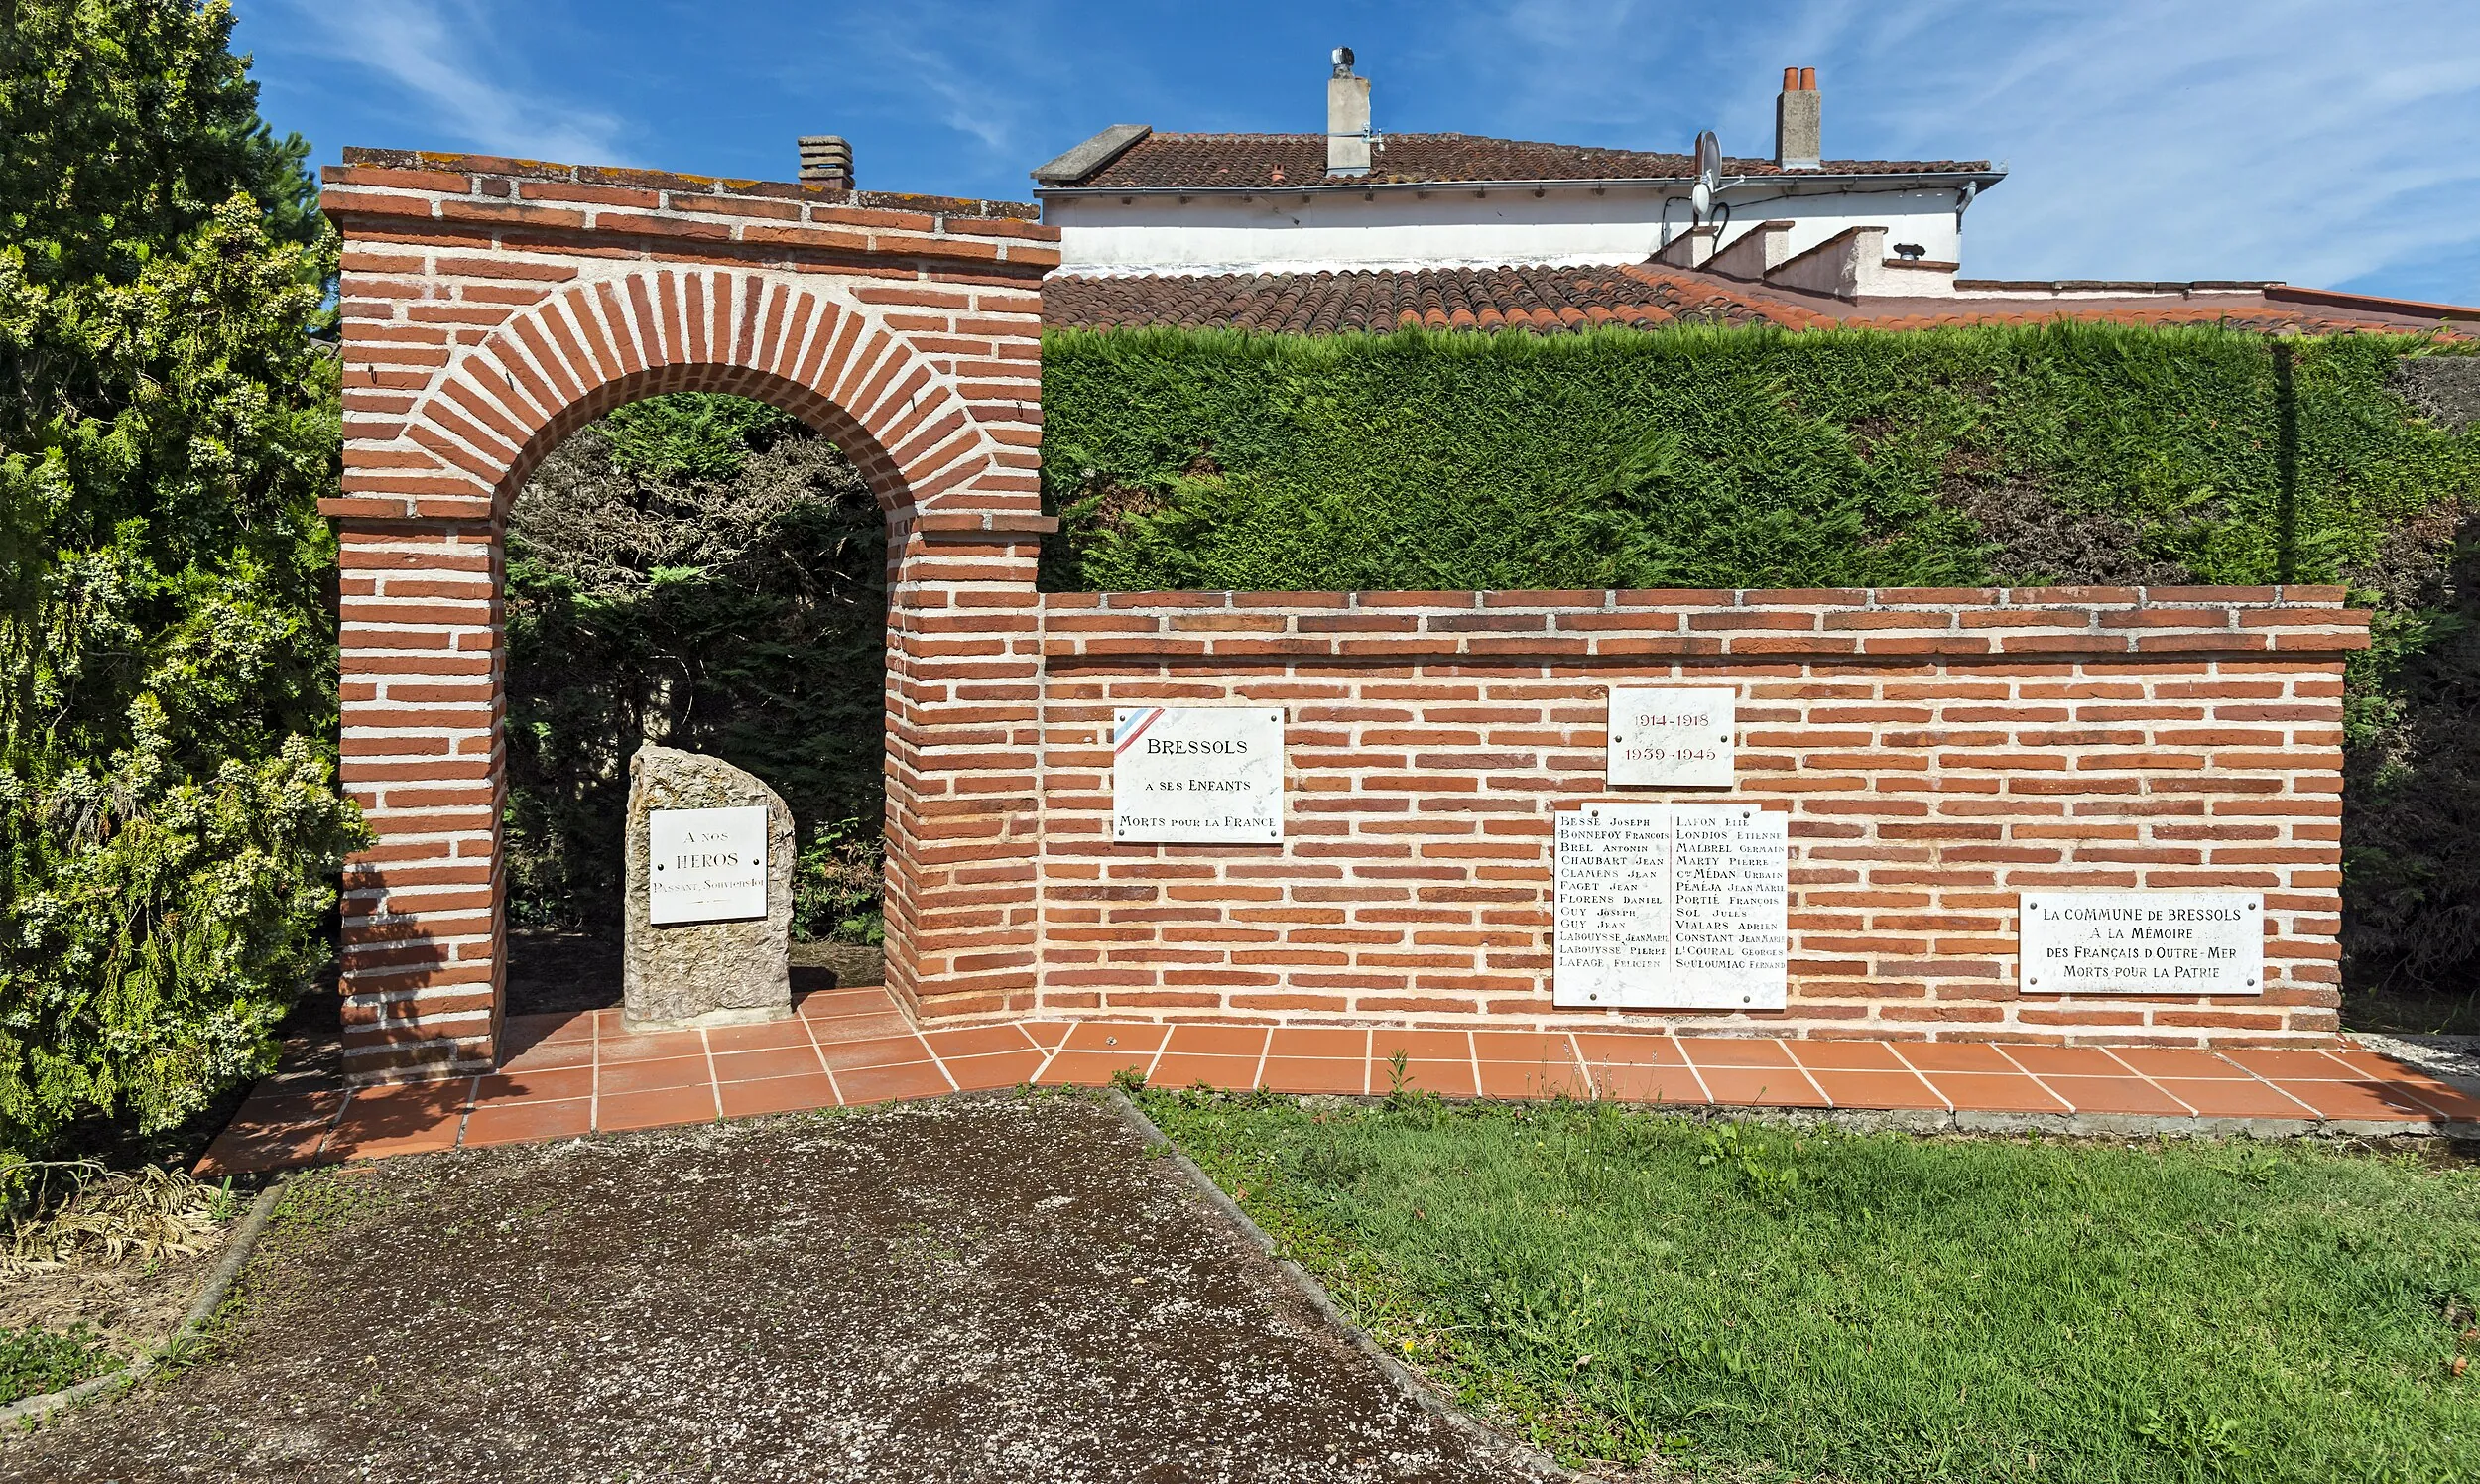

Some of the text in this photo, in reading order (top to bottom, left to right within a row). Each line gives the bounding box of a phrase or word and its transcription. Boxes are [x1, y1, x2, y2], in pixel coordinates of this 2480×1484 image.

[1635, 714, 1709, 727] 1914-1918
[1147, 738, 1248, 755] BRESSOLS
[1159, 781, 1183, 791] SES
[1188, 779, 1251, 791] ENFANTS
[1119, 815, 1166, 827] MORTS
[1224, 816, 1276, 827] FRANCE
[1559, 816, 1650, 827] BESSE JOSEPH
[1676, 816, 1716, 827] LAFON
[683, 832, 729, 844] A NOS
[1559, 829, 1622, 840] BONNEFOY
[1676, 829, 1783, 840] LONDIOS ETIENNE
[1559, 842, 1593, 852] BREL
[1676, 842, 1733, 853] MALBREL
[677, 852, 739, 869] HEROS
[1561, 855, 1628, 865] CHAUBART
[1676, 855, 1769, 866] MARTY PIERRE
[1561, 868, 1619, 878] CLAMENS
[1693, 867, 1736, 879] MÉDAN
[1744, 870, 1783, 879] URBAIN
[1560, 881, 1599, 891] FAGET
[1676, 880, 1722, 892] PÉMÉJA
[1560, 893, 1614, 904] FLORENS
[1675, 894, 1780, 907] PORTIÉ FRANÇOIS
[1560, 906, 1636, 917] GUY JOSEPH
[1676, 907, 1747, 918] SOL JULES
[2043, 908, 2241, 922] LA COMMUNE DE BRESSOLS
[1560, 919, 1587, 928] GUY
[1675, 920, 1729, 930] VIALARS
[1559, 931, 1621, 942] LABOUYSSE
[1675, 932, 1734, 942] CONSTANT
[2089, 926, 2193, 939] A LA MÉMOIRE
[1559, 944, 1667, 955] LABOUYSSE PIERRE
[1687, 945, 1734, 956] COURAL
[2046, 947, 2069, 958] DES
[2074, 945, 2139, 960] FRANÇAIS
[1559, 956, 1604, 967] LAFAGE
[1676, 958, 1745, 969] SOULOUMIAC
[2063, 965, 2220, 978] MORTS POUR LA PATRIE
